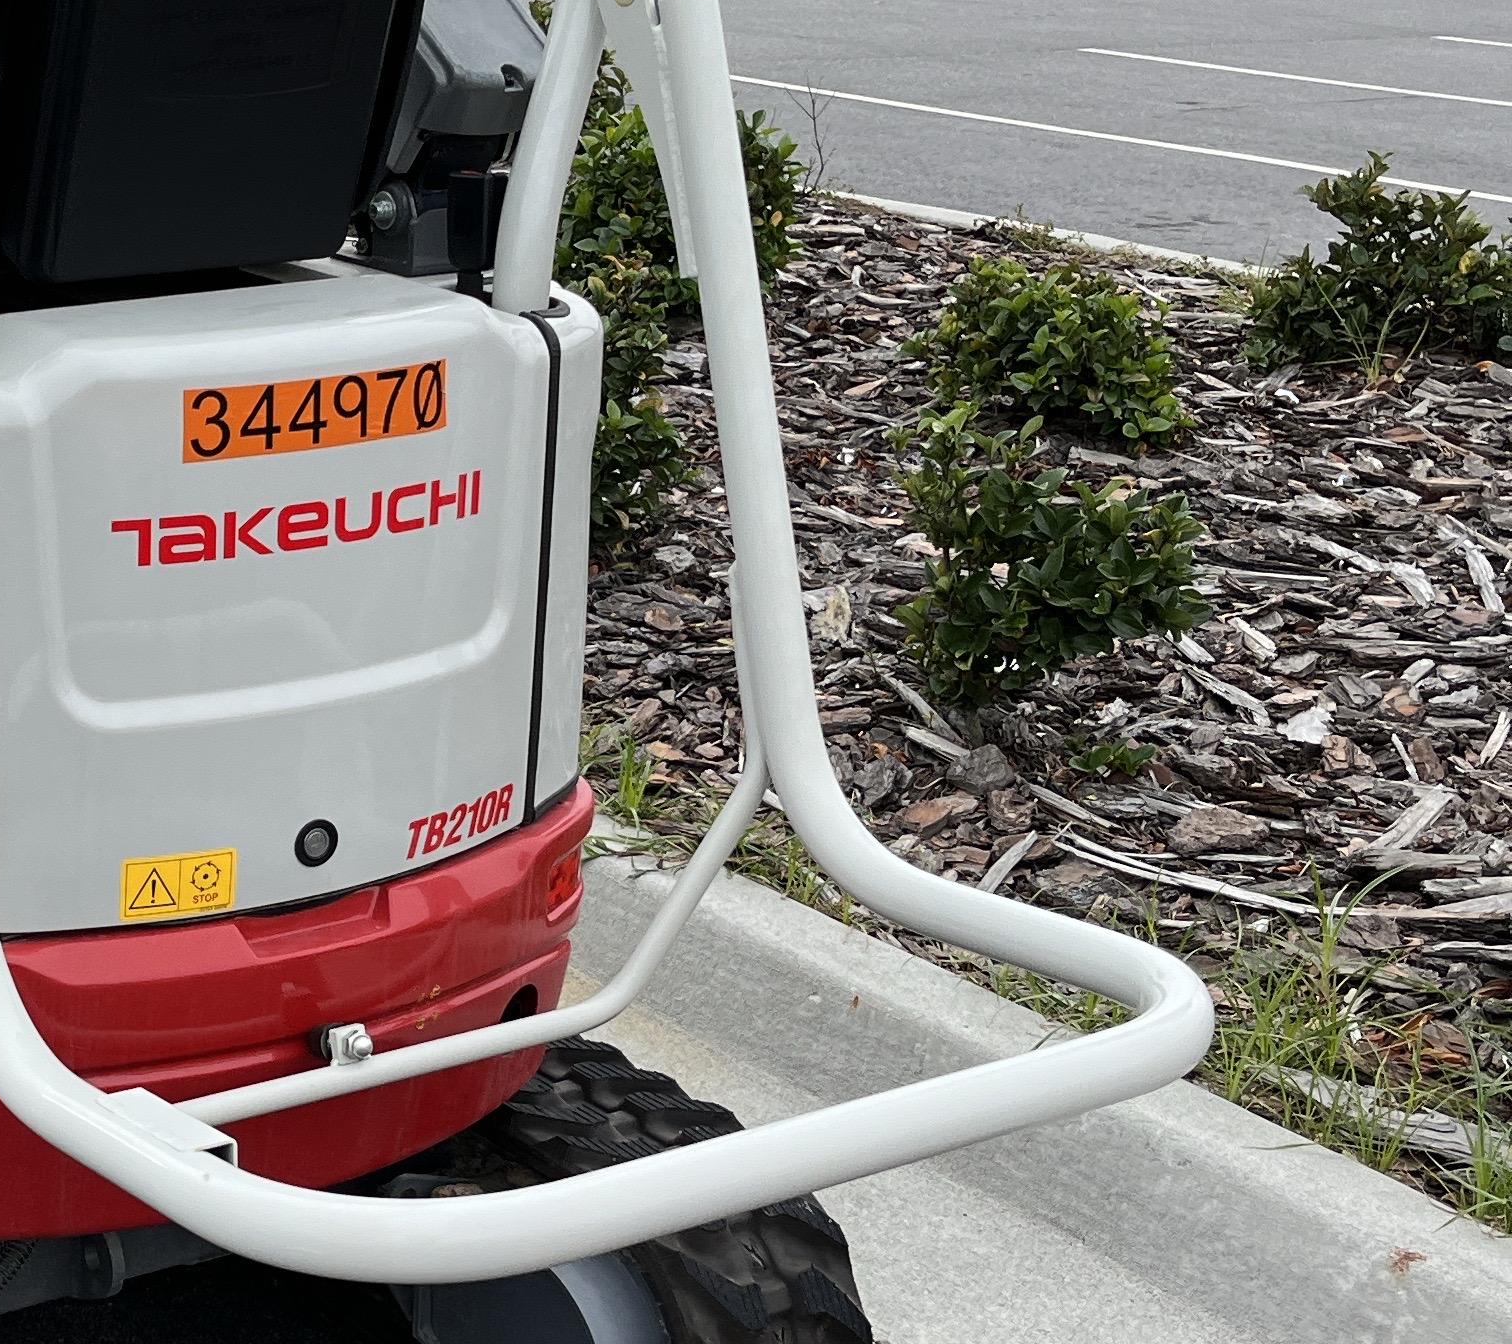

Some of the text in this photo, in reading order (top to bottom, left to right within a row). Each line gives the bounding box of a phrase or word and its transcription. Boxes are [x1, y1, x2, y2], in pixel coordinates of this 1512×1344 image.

[189, 360, 443, 458] 344970
[111, 469, 482, 567] TAKEUCHI
[405, 782, 514, 860] TB210R
[191, 892, 219, 905] STOP
